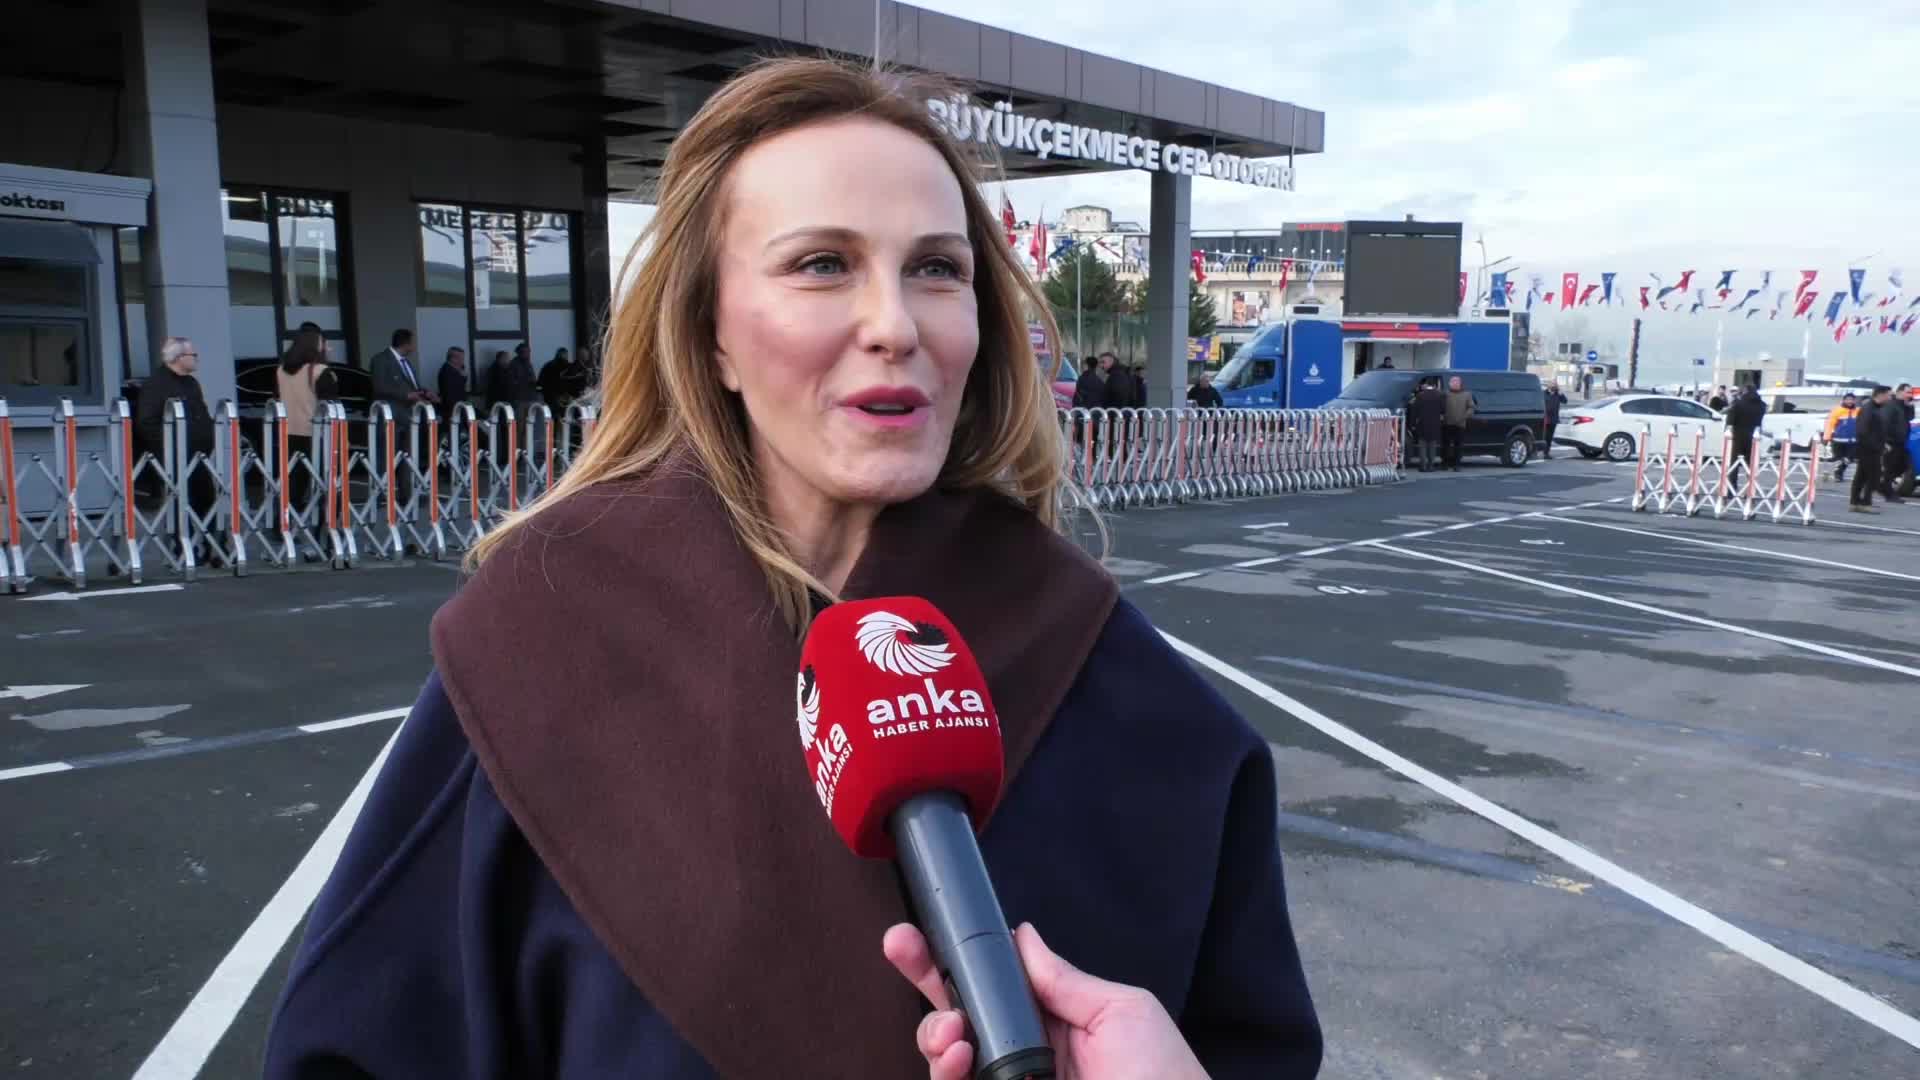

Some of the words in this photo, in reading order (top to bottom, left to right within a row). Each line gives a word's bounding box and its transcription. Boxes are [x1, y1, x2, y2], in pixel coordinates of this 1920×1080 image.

[927, 94, 1160, 171] BÜYÜKÇEKMECE
[1162, 143, 1209, 176] CEP
[866, 678, 984, 724] anka
[873, 720, 930, 739] HABER
[935, 716, 989, 728] AJANSI
[816, 723, 848, 807] anka
